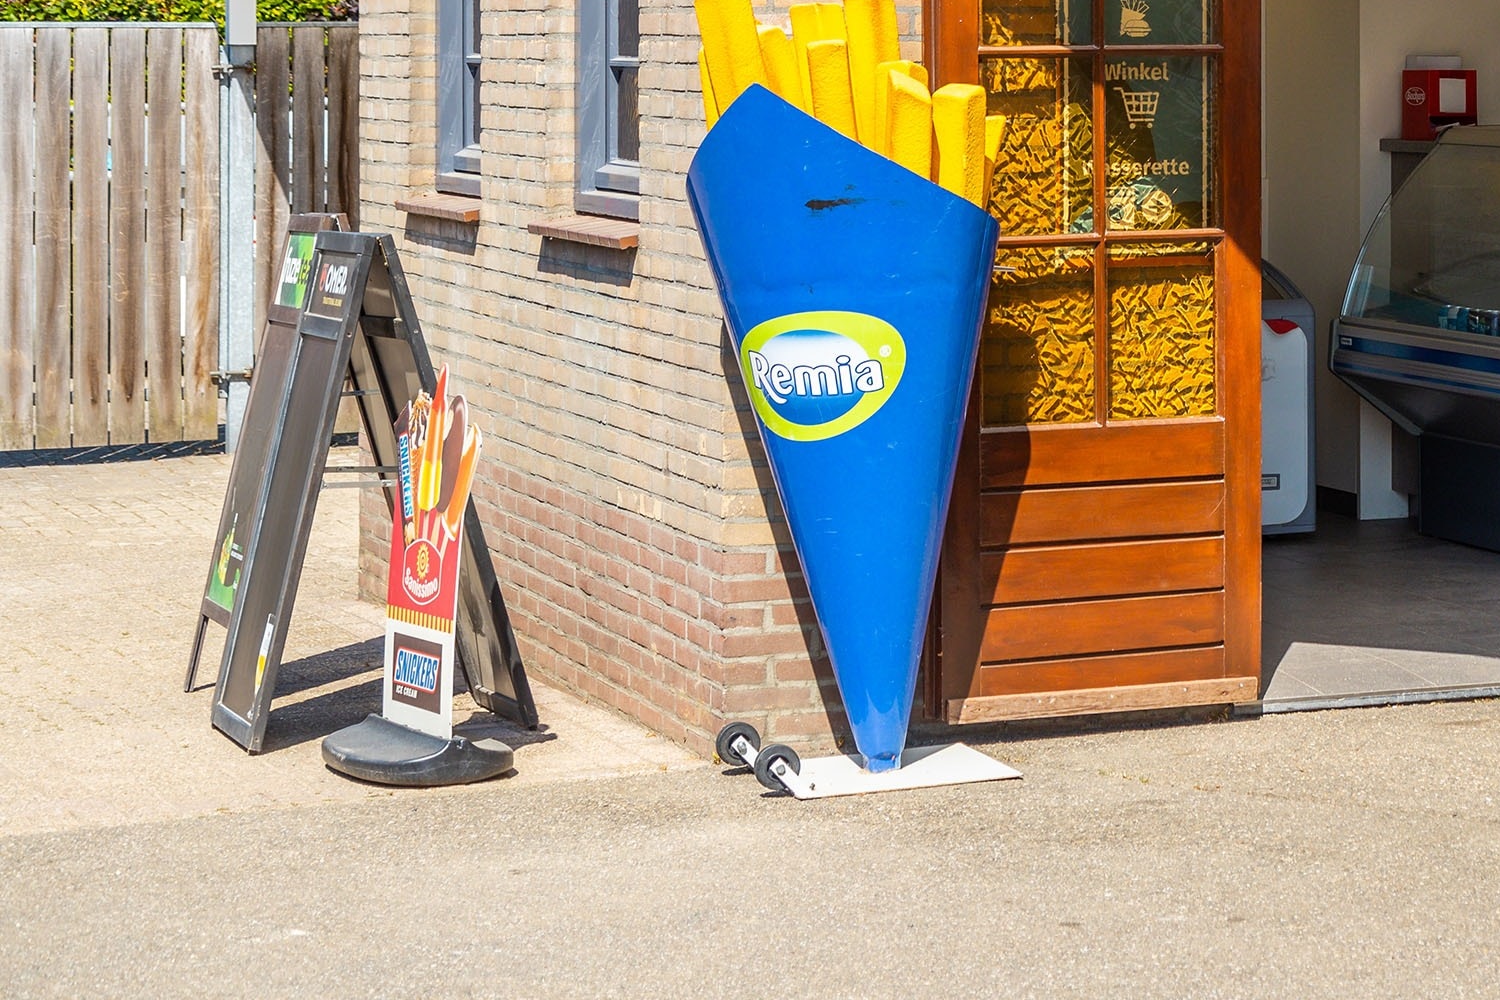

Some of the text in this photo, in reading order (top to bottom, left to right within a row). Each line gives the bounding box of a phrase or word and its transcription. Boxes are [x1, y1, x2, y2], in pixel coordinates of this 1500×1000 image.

[1104, 61, 1169, 81] Winkel
[748, 350, 885, 404] Remia
[400, 433, 414, 518] SNICKERS
[395, 649, 439, 692] SNICKERS
